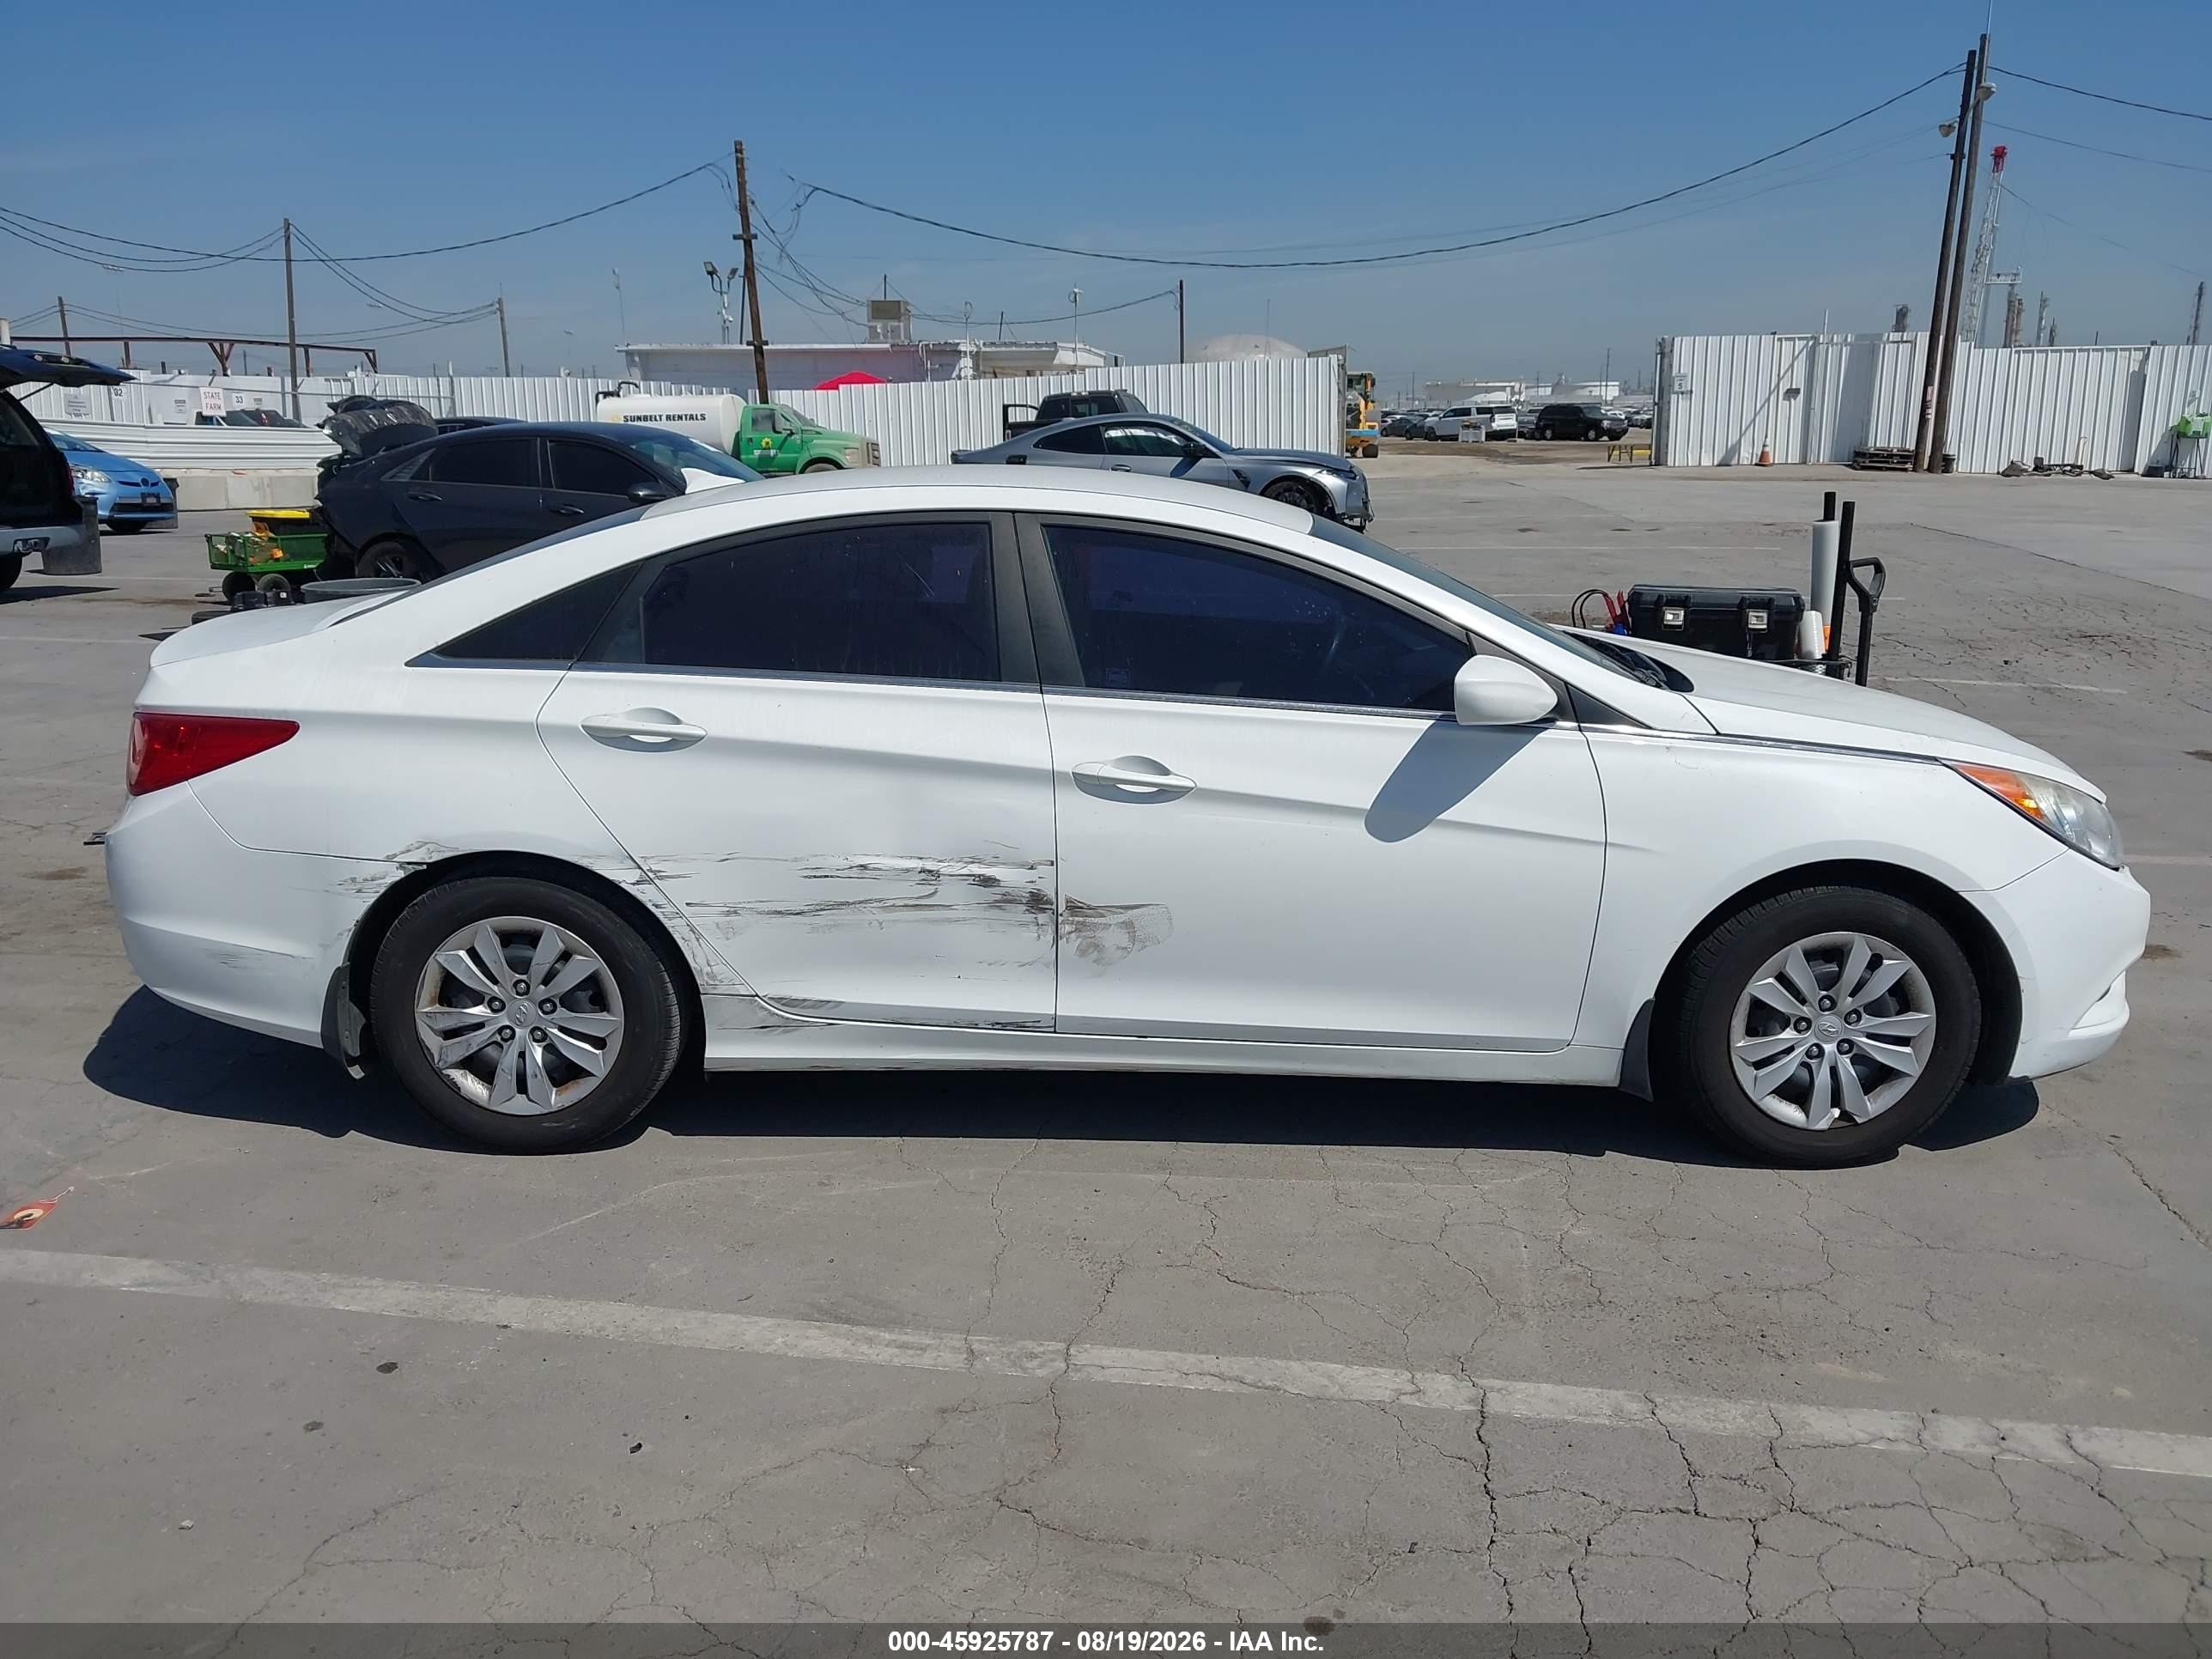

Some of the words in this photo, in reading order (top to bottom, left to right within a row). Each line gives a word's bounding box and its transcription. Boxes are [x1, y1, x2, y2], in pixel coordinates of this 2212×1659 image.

[113, 387, 124, 397] 32
[204, 391, 221, 400] STATE
[235, 395, 244, 404] 33
[205, 403, 222, 411] FARM
[623, 414, 663, 422] SUNBELT
[665, 413, 706, 422] RENTALS
